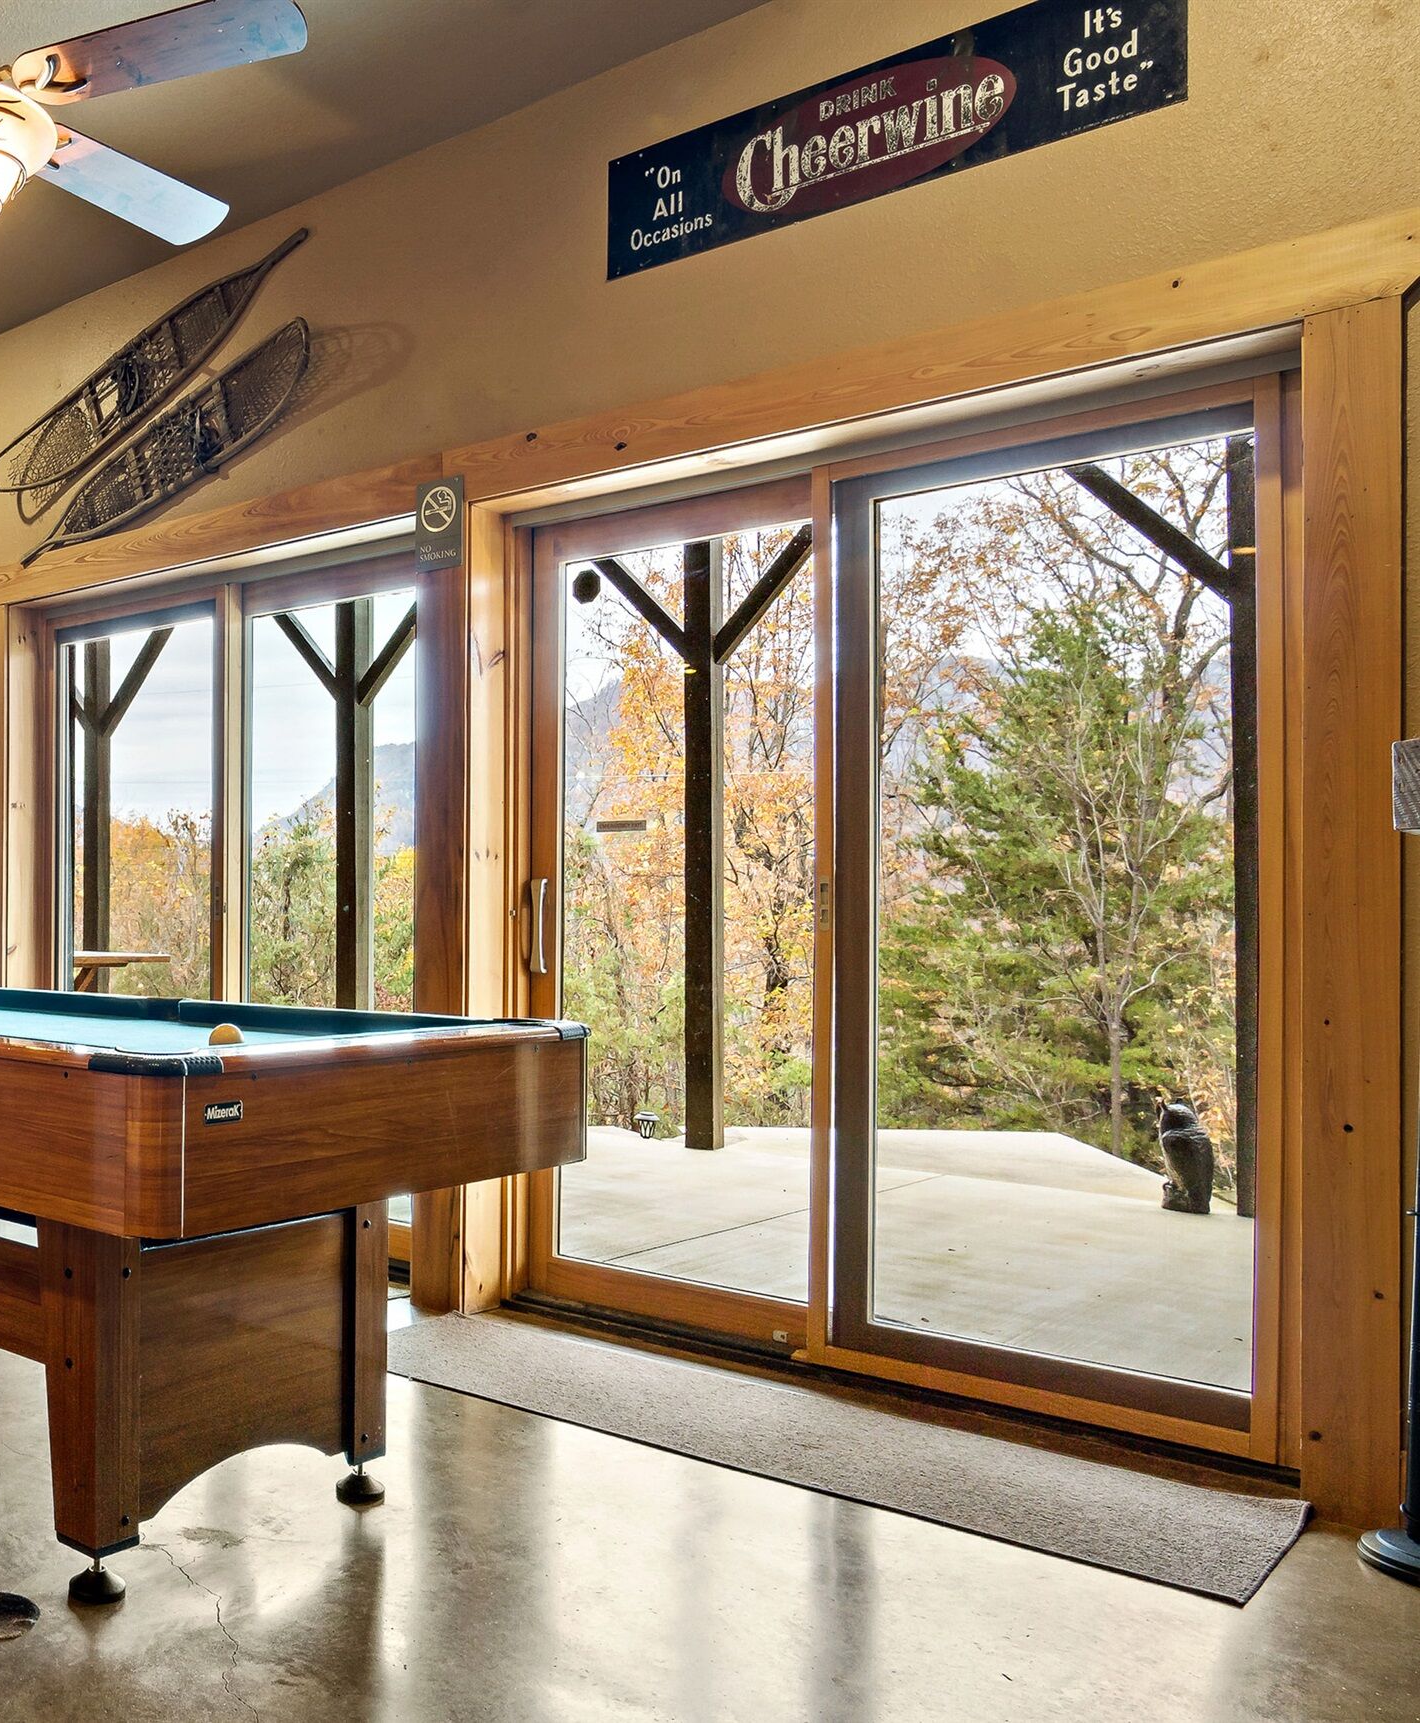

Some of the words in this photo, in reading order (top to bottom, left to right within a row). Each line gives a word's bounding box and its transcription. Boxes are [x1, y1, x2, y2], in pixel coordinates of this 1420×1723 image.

[1083, 7, 1122, 38] It's
[1062, 27, 1138, 78] Good
[818, 76, 897, 122] DRINK
[1055, 60, 1154, 112] Taste"
[735, 73, 1006, 213] Cheerwine
[644, 165, 681, 189] "On
[652, 190, 683, 221] All
[630, 213, 713, 251] Occasions
[420, 544, 431, 553] NO
[420, 549, 456, 561] SMOKING
